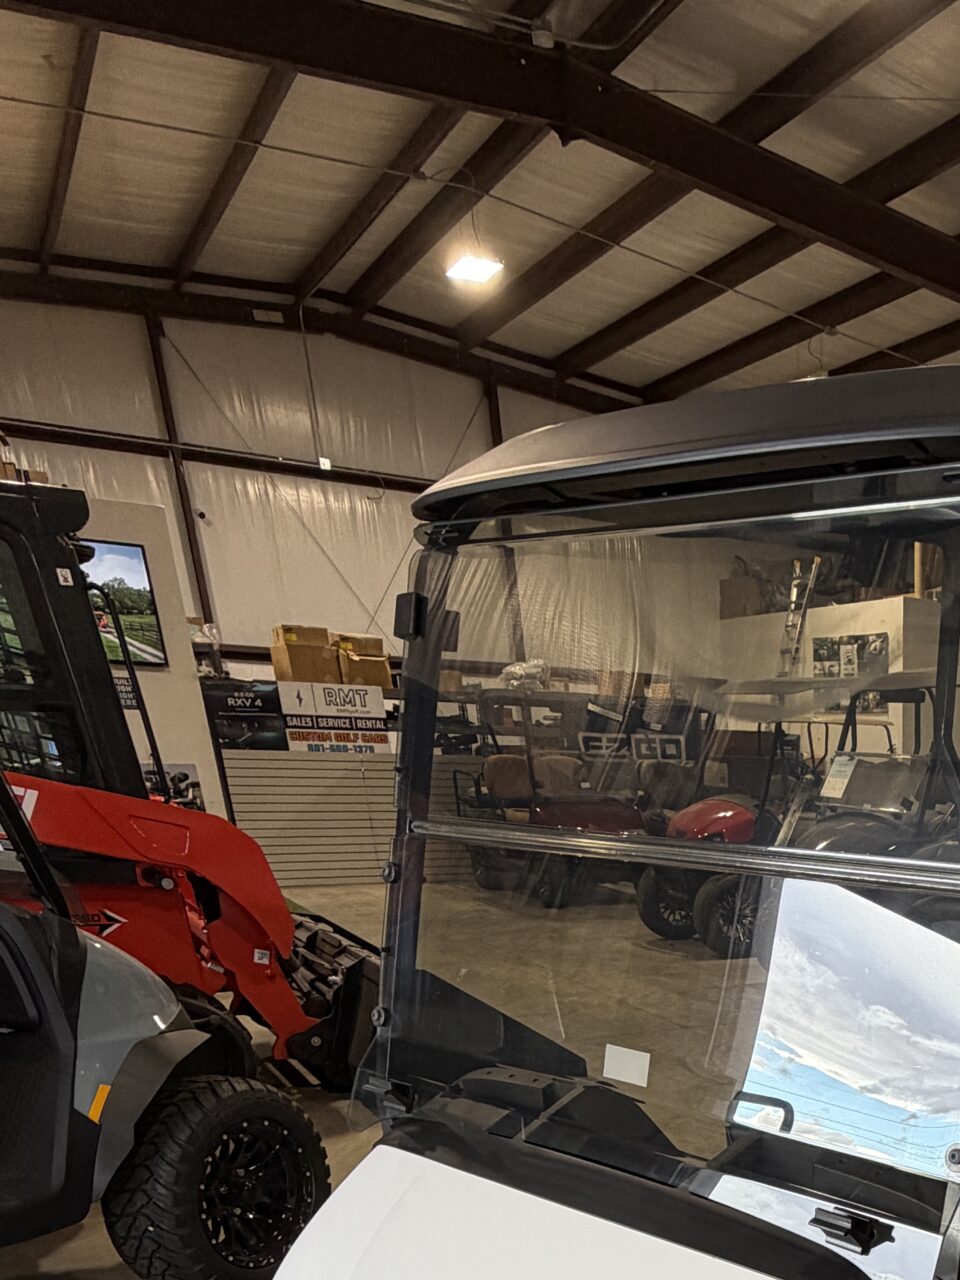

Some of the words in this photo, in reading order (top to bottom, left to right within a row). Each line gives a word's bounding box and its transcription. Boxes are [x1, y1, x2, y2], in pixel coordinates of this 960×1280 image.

[227, 697, 251, 707] RXV
[255, 699, 263, 708] 4
[323, 687, 368, 708] RMT
[286, 716, 312, 727] SALES
[317, 718, 351, 729] SERVICE
[357, 719, 386, 729] RENTAL
[288, 730, 333, 743] CUSTOM
[334, 732, 359, 743] GOLF
[360, 733, 388, 744] CARS
